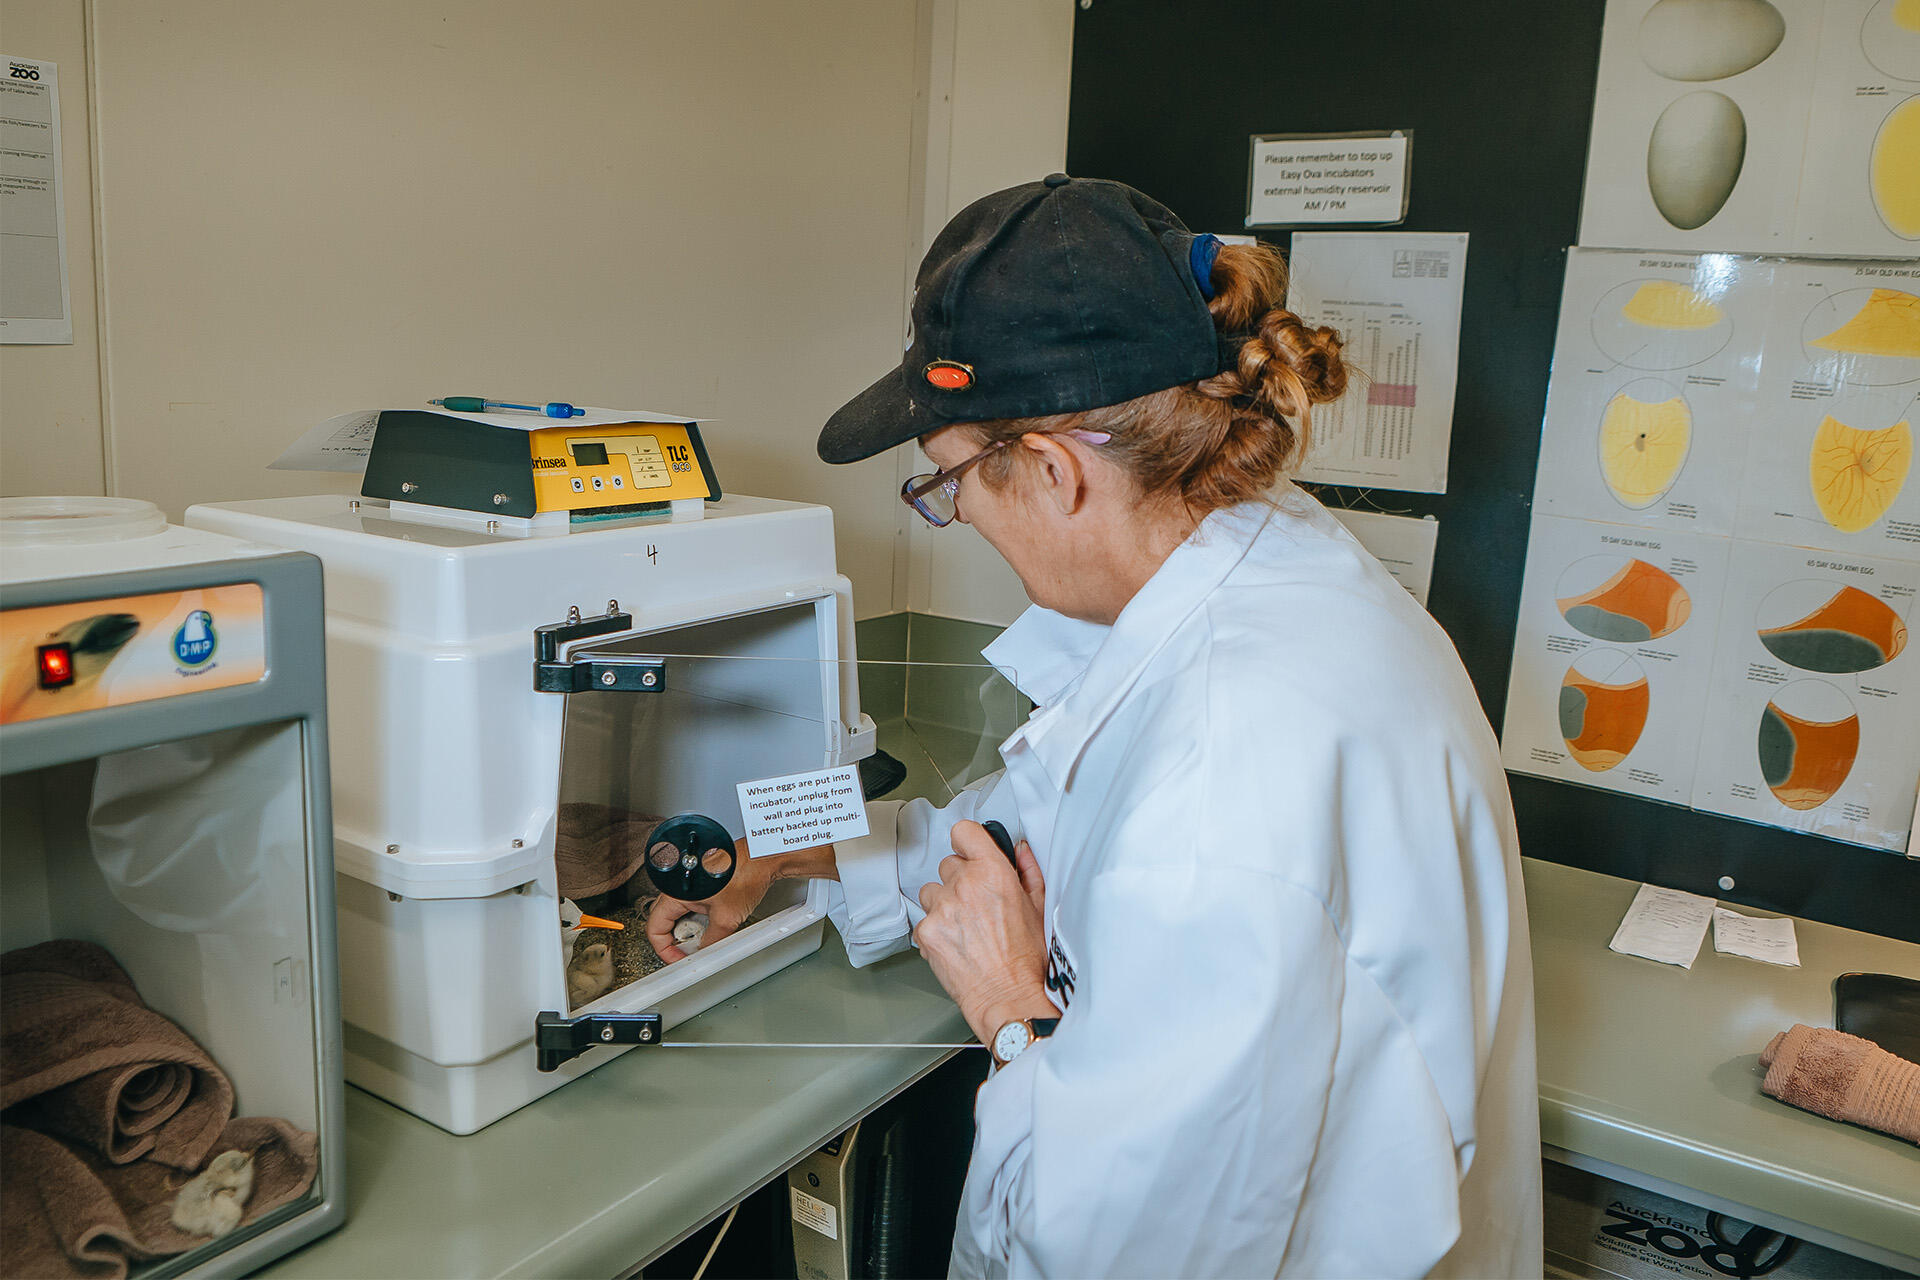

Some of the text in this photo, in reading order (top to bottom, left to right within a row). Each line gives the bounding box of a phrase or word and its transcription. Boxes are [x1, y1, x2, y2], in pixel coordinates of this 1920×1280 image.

[1264, 151, 1393, 165] Please remember to top up
[1280, 169, 1301, 180] Easy
[1324, 167, 1375, 178] incubators
[1263, 183, 1391, 196] external humidity reservoir
[1303, 200, 1321, 210] AM
[1330, 200, 1346, 210] PM
[666, 445, 689, 462] TLC
[672, 462, 691, 473] eco
[646, 543, 658, 566] 4
[746, 773, 851, 796] When eggs are put into
[749, 787, 853, 810] incubator, unplug from
[763, 801, 844, 821] wall and plug into
[751, 811, 861, 838] battery backed up multi-
[783, 830, 834, 846] board plug.
[1596, 1234, 1713, 1278] Wildlife Conservation
[1639, 1254, 1650, 1263] at
[1652, 1258, 1683, 1274] Work
